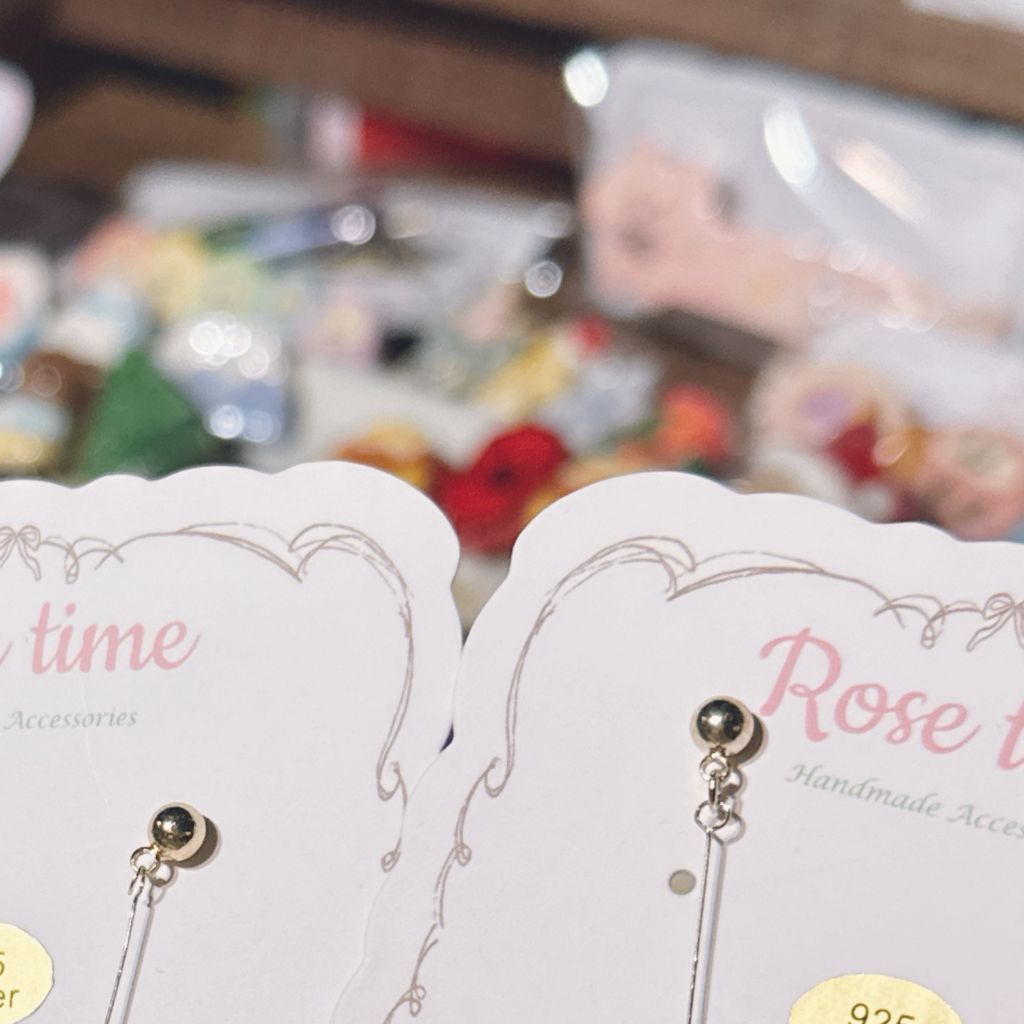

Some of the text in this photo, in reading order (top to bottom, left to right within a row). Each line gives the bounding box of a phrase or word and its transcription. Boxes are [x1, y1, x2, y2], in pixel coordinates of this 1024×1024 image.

[30, 601, 201, 675] time
[3, 709, 137, 732] Accessories
[759, 627, 982, 754] Rose
[785, 763, 943, 817] Handmade
